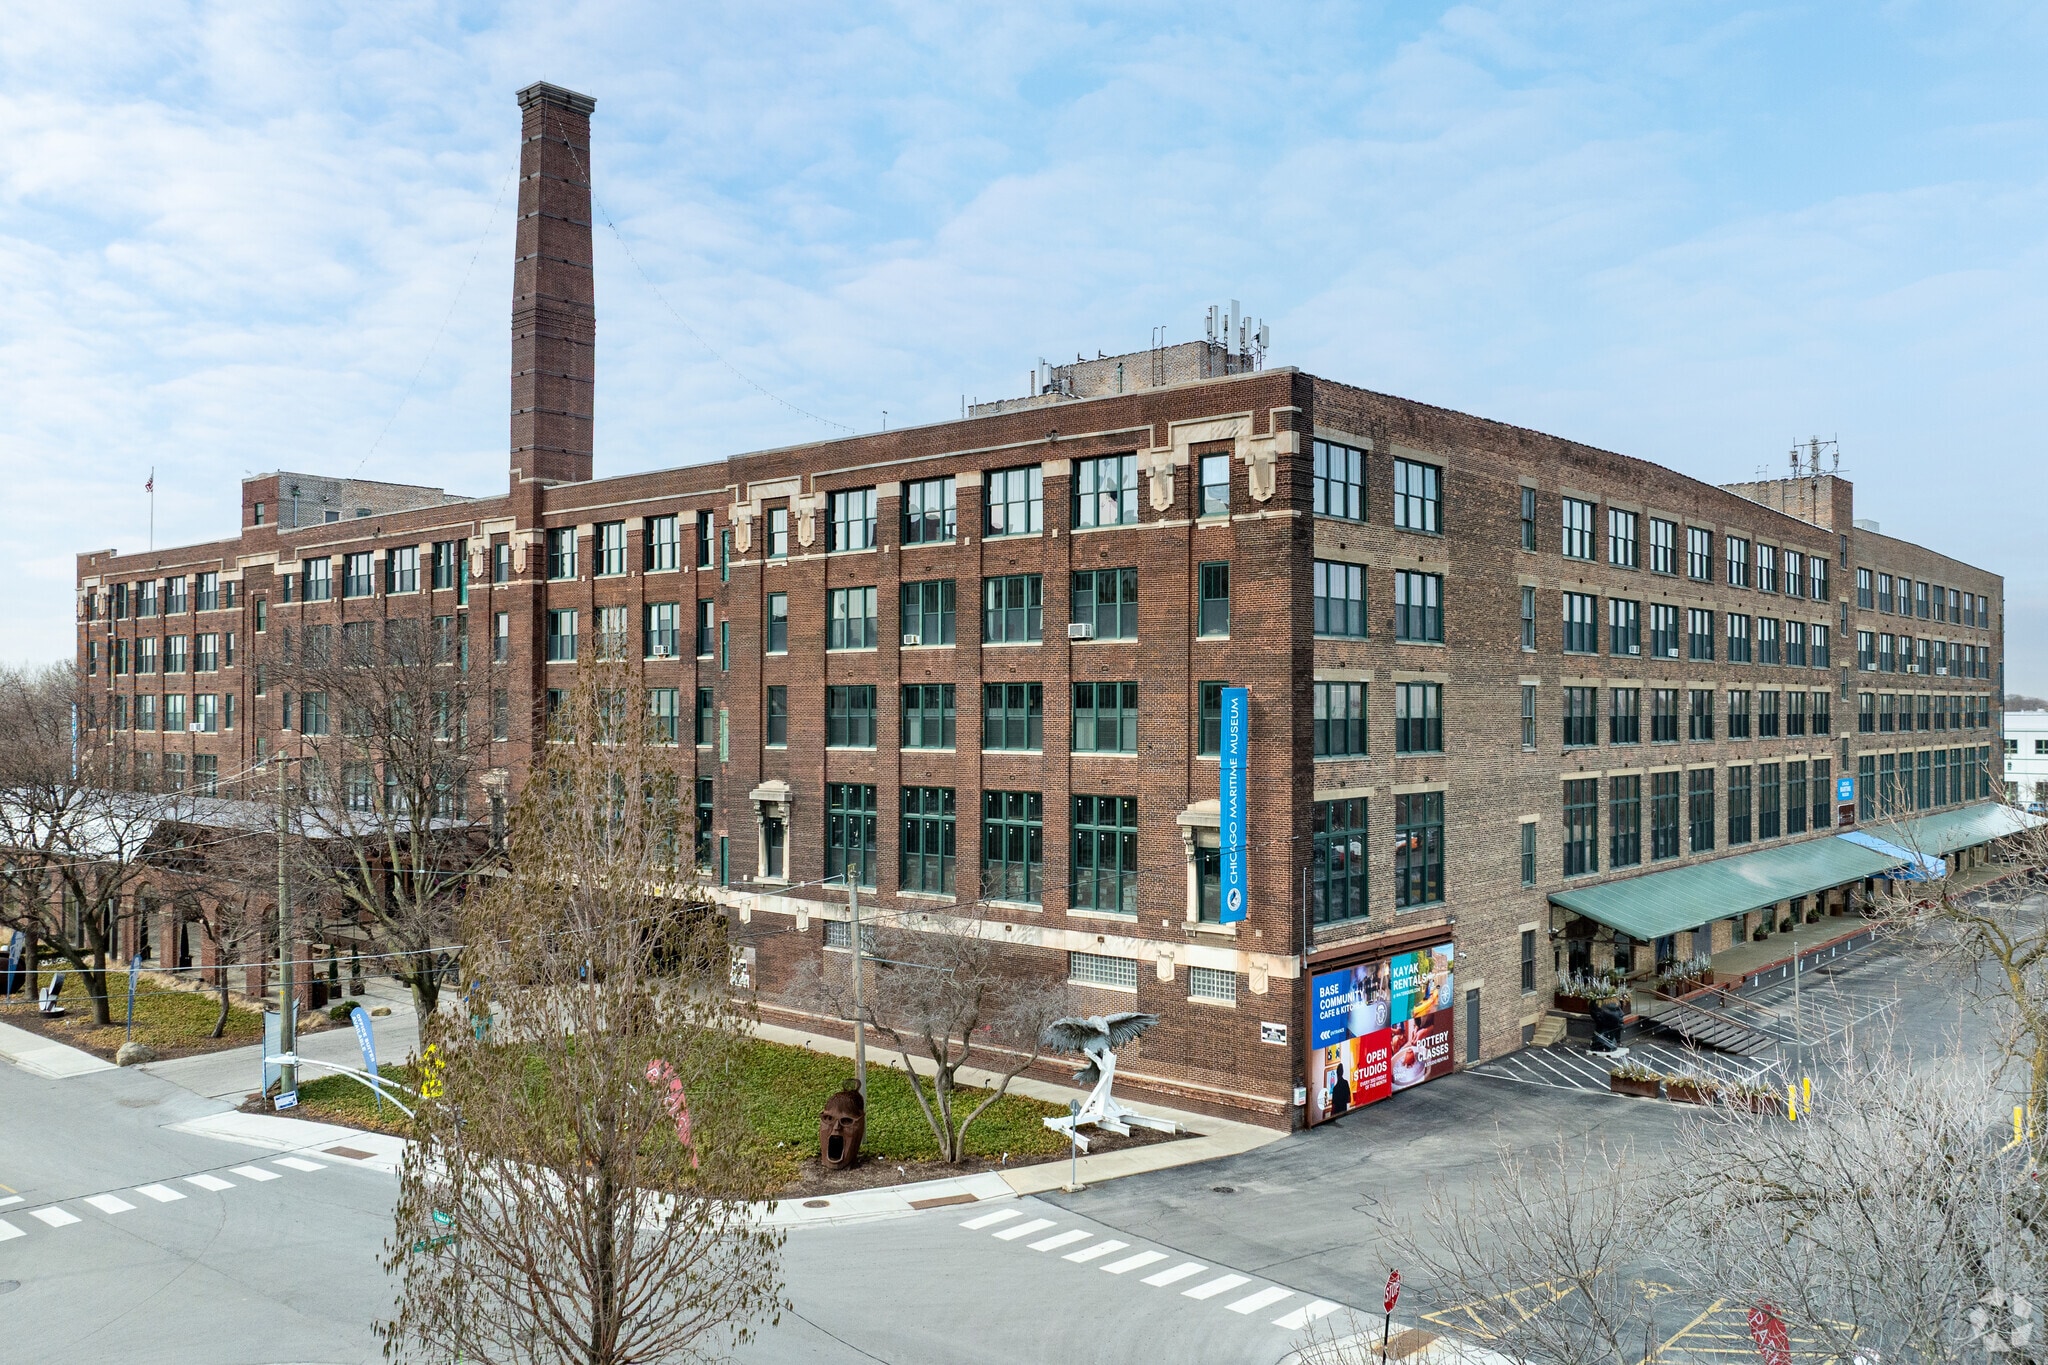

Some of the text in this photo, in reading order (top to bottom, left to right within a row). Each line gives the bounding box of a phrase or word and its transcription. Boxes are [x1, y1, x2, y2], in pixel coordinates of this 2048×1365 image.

[1229, 697, 1239, 884] CHICAGO MARITIME MUSEUM
[1393, 963, 1418, 978] KAYAK
[1320, 984, 1339, 997] BASE
[1393, 973, 1427, 991] RENTALS
[1320, 990, 1364, 1010] COMMUNITY
[1320, 1009, 1335, 1019] CAFE
[1335, 1007, 1341, 1016] &
[352, 1016, 366, 1052] AVAILABLE
[356, 1014, 375, 1062] OFFICE SUITES
[1417, 1031, 1449, 1048] POTTERY
[1366, 1048, 1387, 1064] OPEN
[1417, 1042, 1449, 1062] CLASSES
[1354, 1061, 1387, 1081] STUDIOS
[1385, 1280, 1400, 1303] STOP
